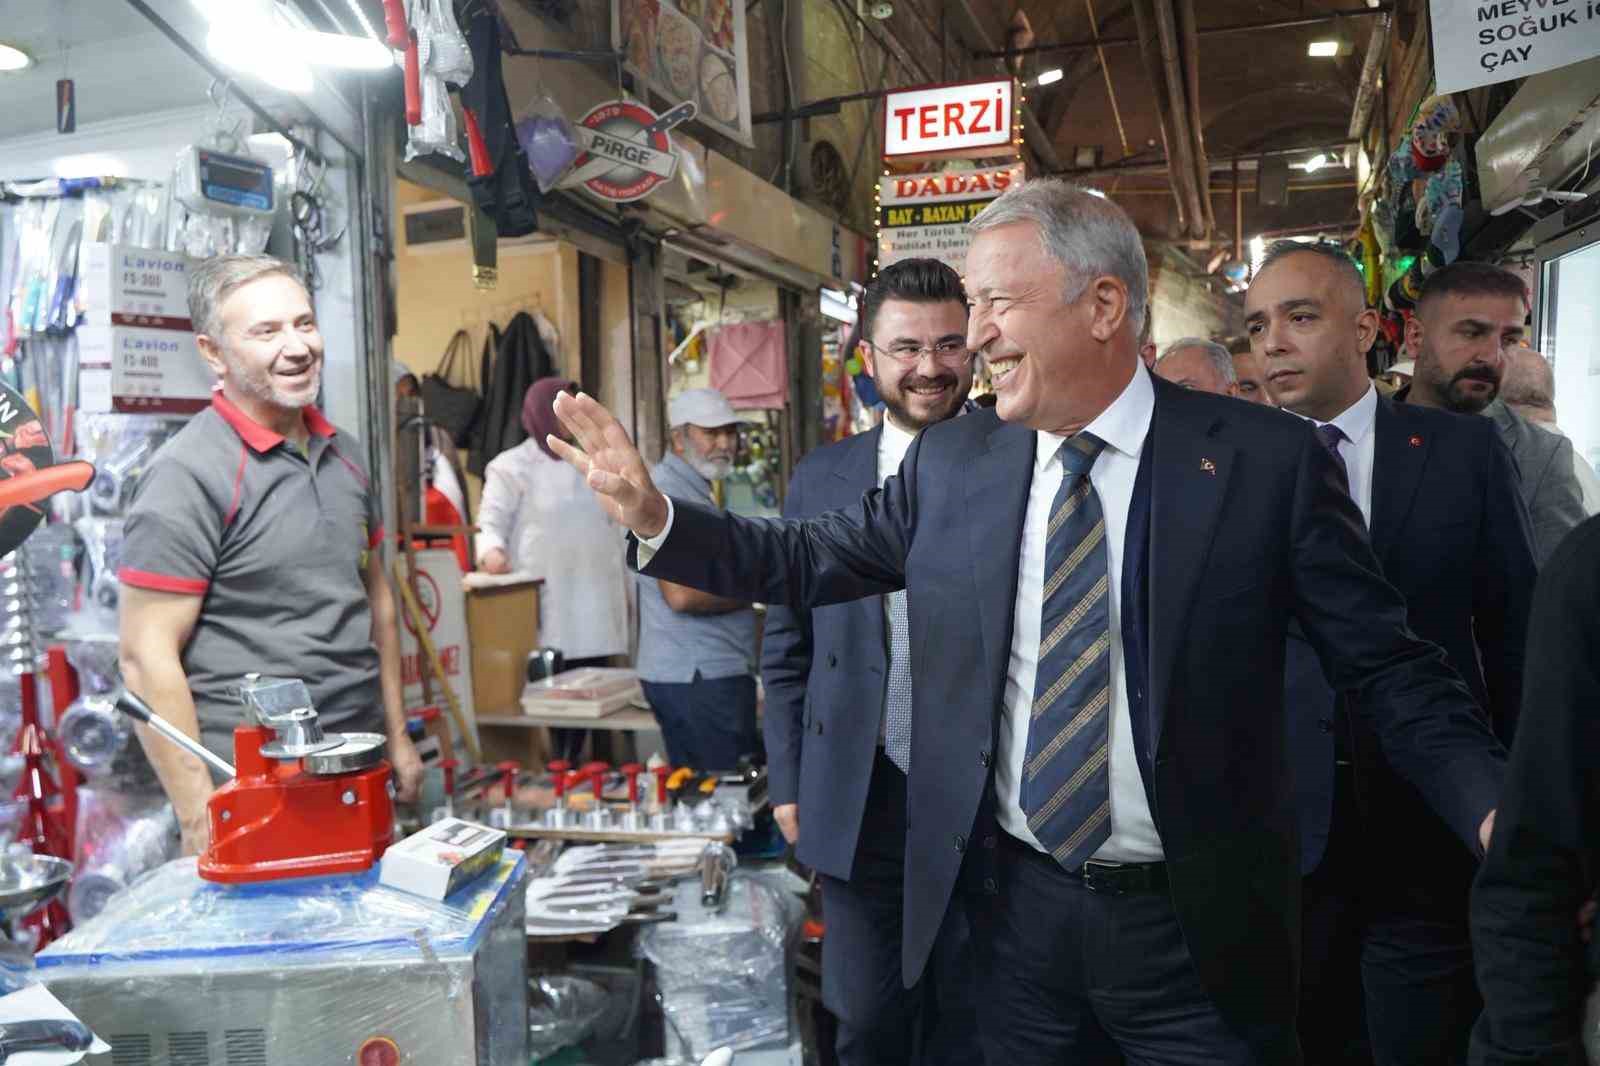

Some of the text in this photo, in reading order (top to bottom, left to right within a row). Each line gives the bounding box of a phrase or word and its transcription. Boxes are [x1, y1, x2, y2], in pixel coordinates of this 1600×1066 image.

[1479, 9, 1578, 45] SOĞUK
[1480, 44, 1532, 72] ÇAY
[894, 88, 1003, 141] TERZİ
[887, 207, 914, 226] BAY
[922, 204, 965, 224] BAYAN
[123, 256, 185, 272] Lavion
[123, 337, 179, 351] Lavion
